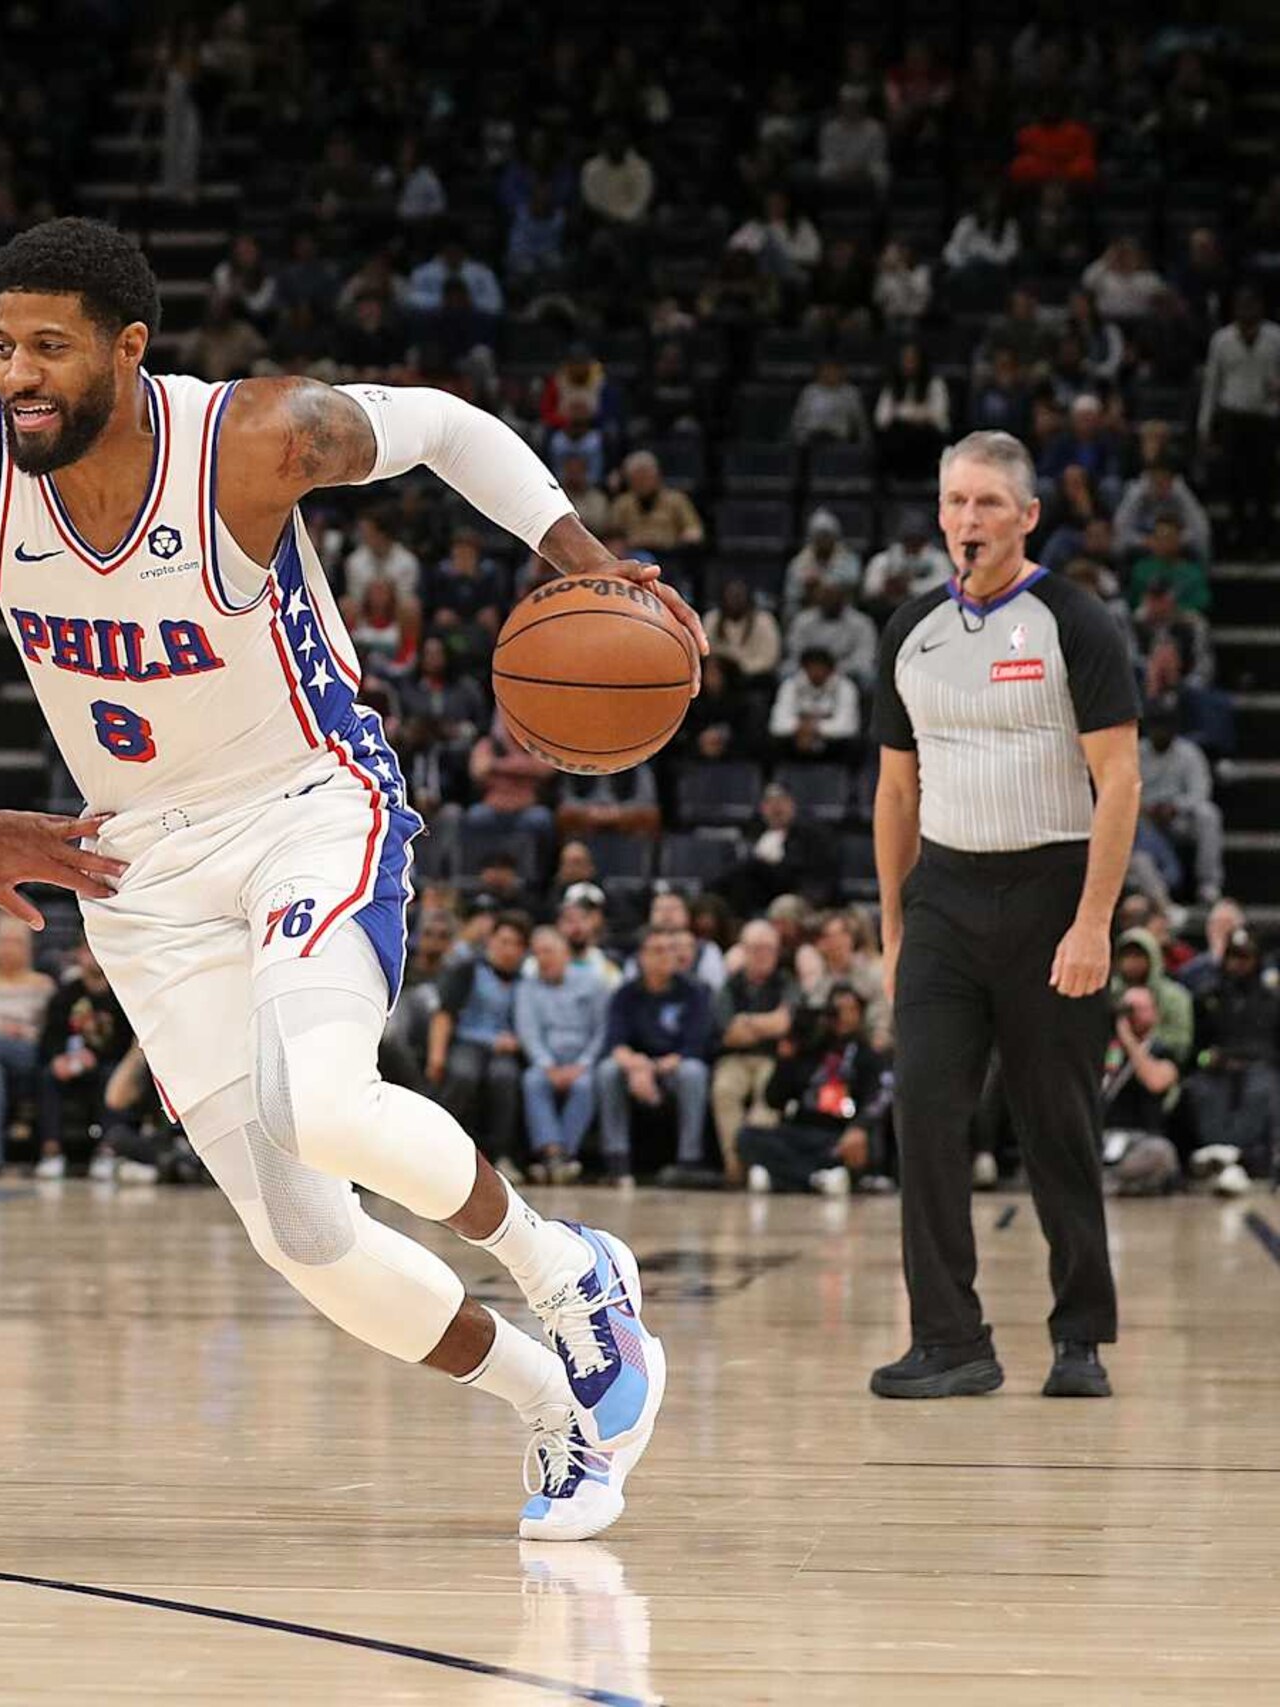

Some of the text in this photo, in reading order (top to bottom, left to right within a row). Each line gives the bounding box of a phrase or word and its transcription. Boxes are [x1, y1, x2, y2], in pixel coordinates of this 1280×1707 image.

[140, 560, 200, 580] crypto.com
[10, 607, 226, 682] PHILA
[991, 662, 1043, 679] Emirates
[90, 699, 157, 763] 8
[261, 898, 316, 950] 76
